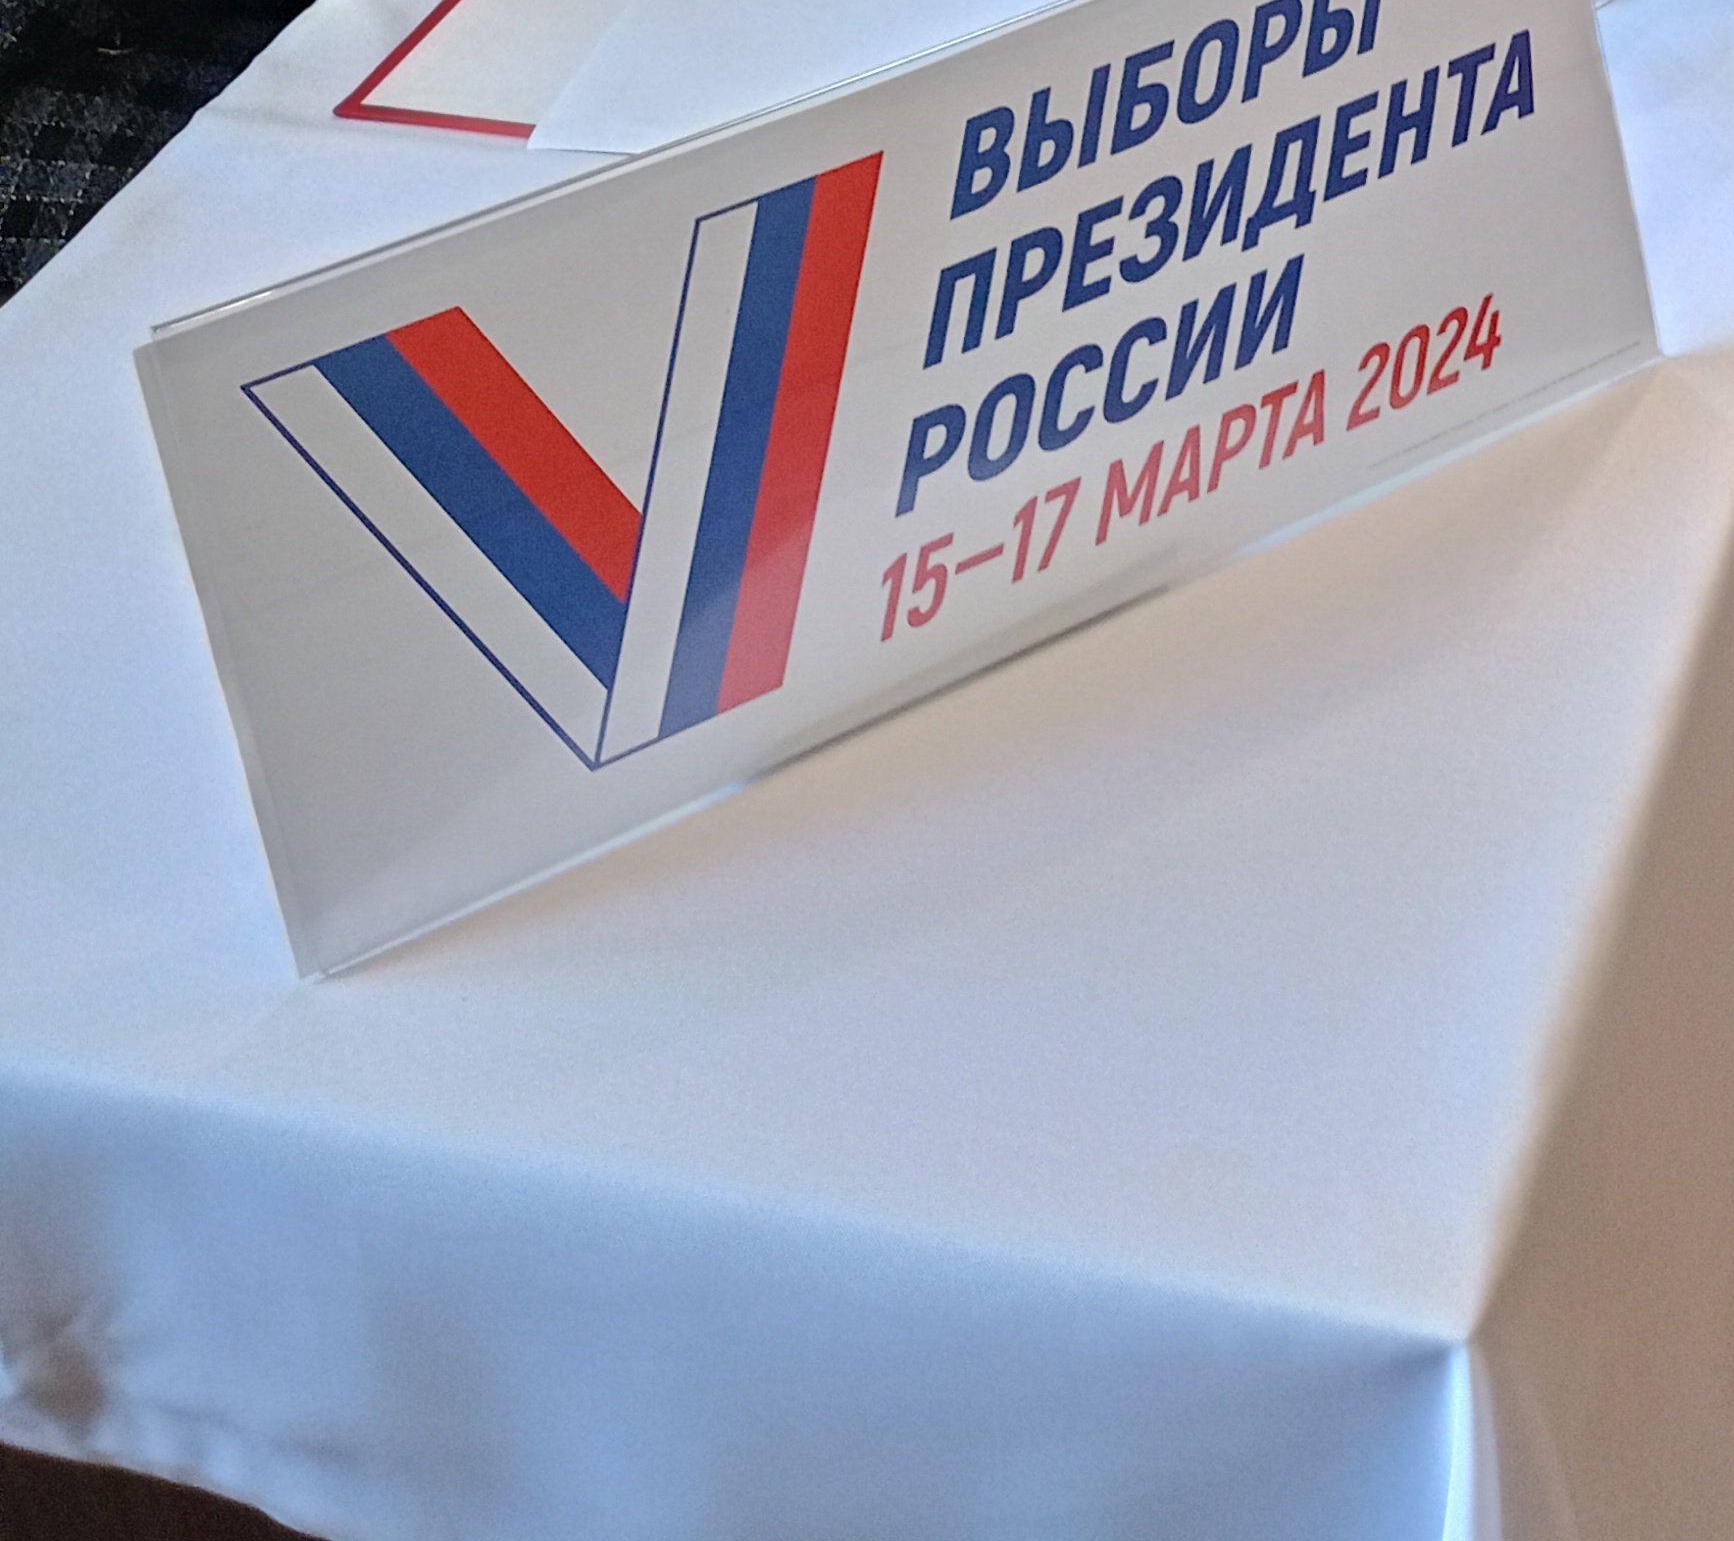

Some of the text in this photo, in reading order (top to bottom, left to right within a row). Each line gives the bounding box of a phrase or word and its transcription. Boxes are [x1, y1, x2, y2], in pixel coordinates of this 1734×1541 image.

[924, 34, 1534, 368] ПРЕЗИДЕНТА
[896, 256, 1304, 515] РОССИИ
[1095, 370, 1326, 546] МАРТА
[1347, 293, 1503, 431] 2024
